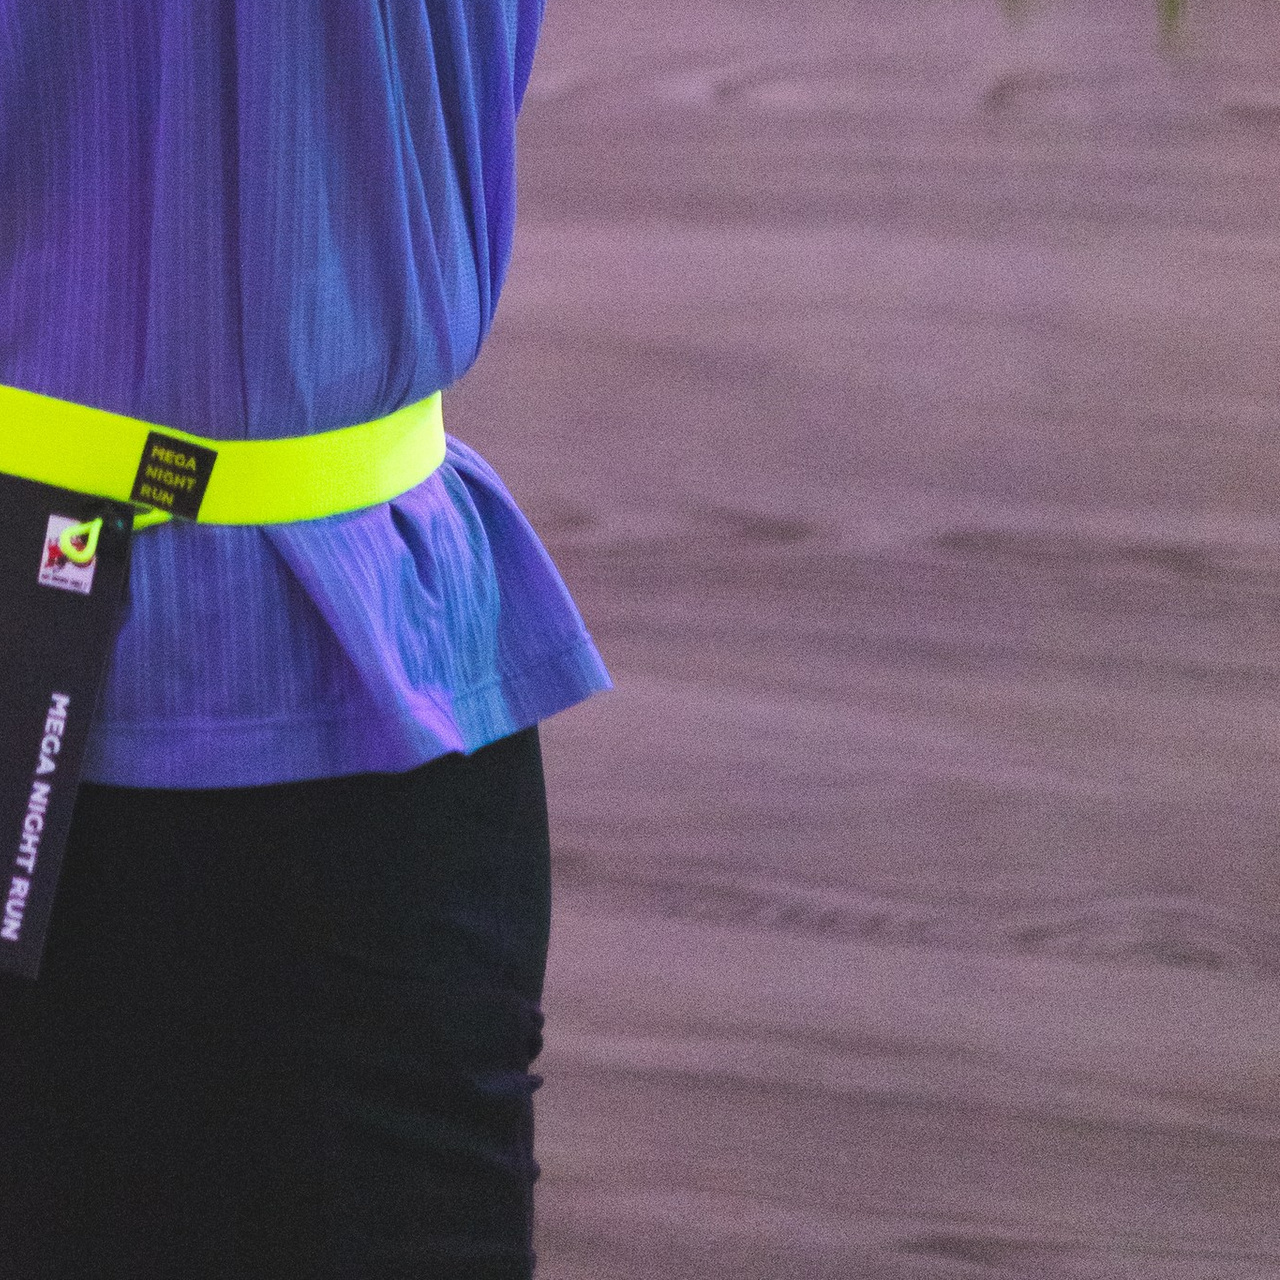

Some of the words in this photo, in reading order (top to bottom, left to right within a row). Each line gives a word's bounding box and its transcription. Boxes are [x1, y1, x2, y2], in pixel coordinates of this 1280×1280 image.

[145, 464, 197, 490] NIGHT
[151, 445, 197, 471] MEGA
[140, 483, 174, 506] RUN
[36, 692, 70, 775] MEGA
[16, 780, 51, 874] NIGHT
[0, 876, 30, 941] RUN
